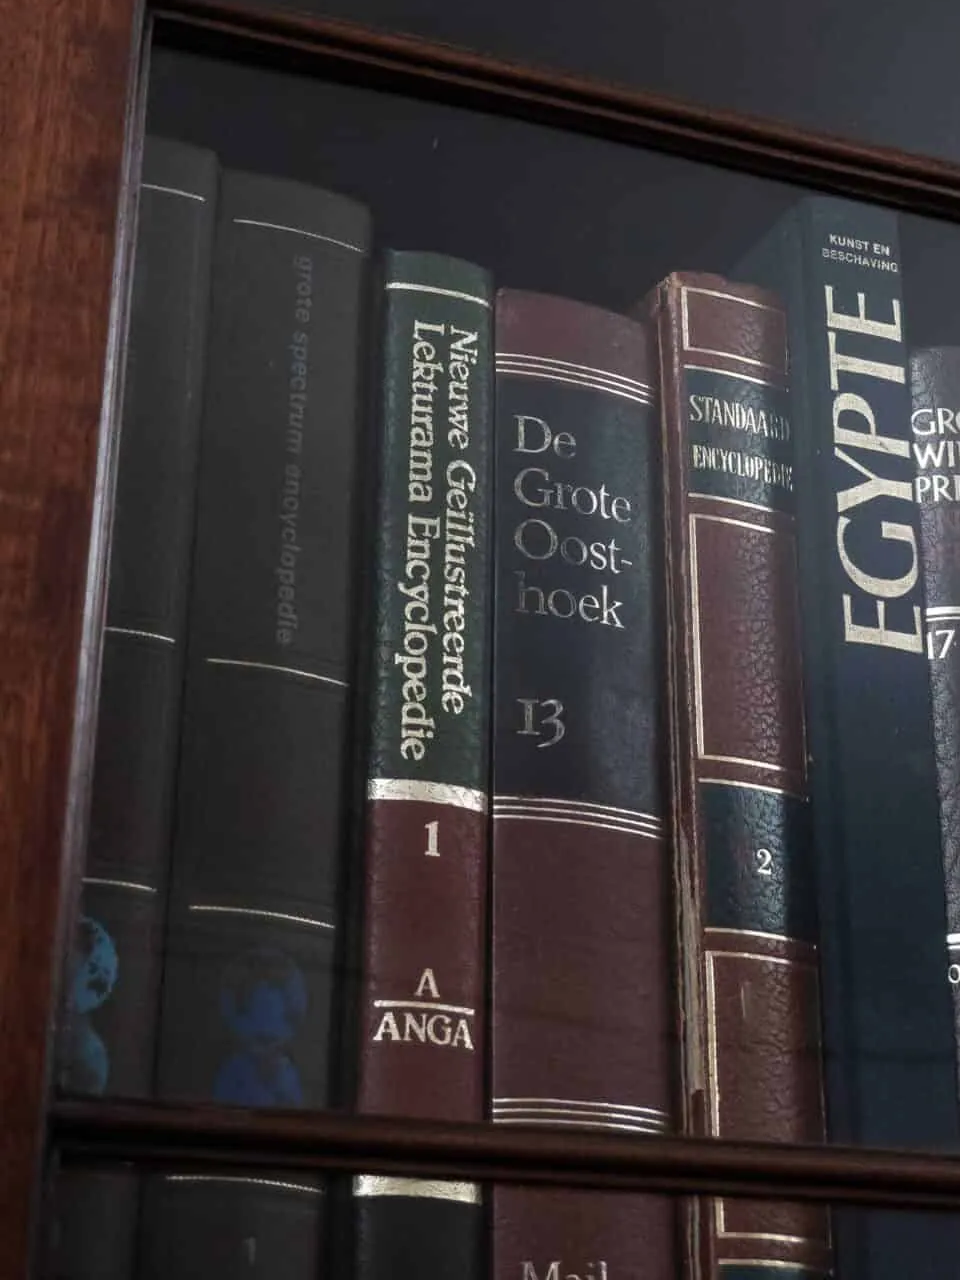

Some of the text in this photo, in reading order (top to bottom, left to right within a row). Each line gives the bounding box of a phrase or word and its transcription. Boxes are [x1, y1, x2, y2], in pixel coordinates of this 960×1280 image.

[822, 248, 898, 272] BESCHAVING
[829, 234, 890, 257] KUNST EN
[447, 325, 479, 448] Nieuwe
[513, 414, 577, 458] De
[825, 284, 924, 654] EGYPTE
[513, 468, 632, 523] Grote
[400, 320, 445, 762] Lekturama Encyclopedie
[513, 518, 633, 575] Oost-
[515, 569, 626, 628] hoek
[927, 629, 956, 661] 17
[515, 698, 566, 748] 13
[424, 820, 441, 858] 1
[756, 847, 774, 877] 2
[414, 967, 440, 999] A
[373, 1010, 475, 1051] ANGA
